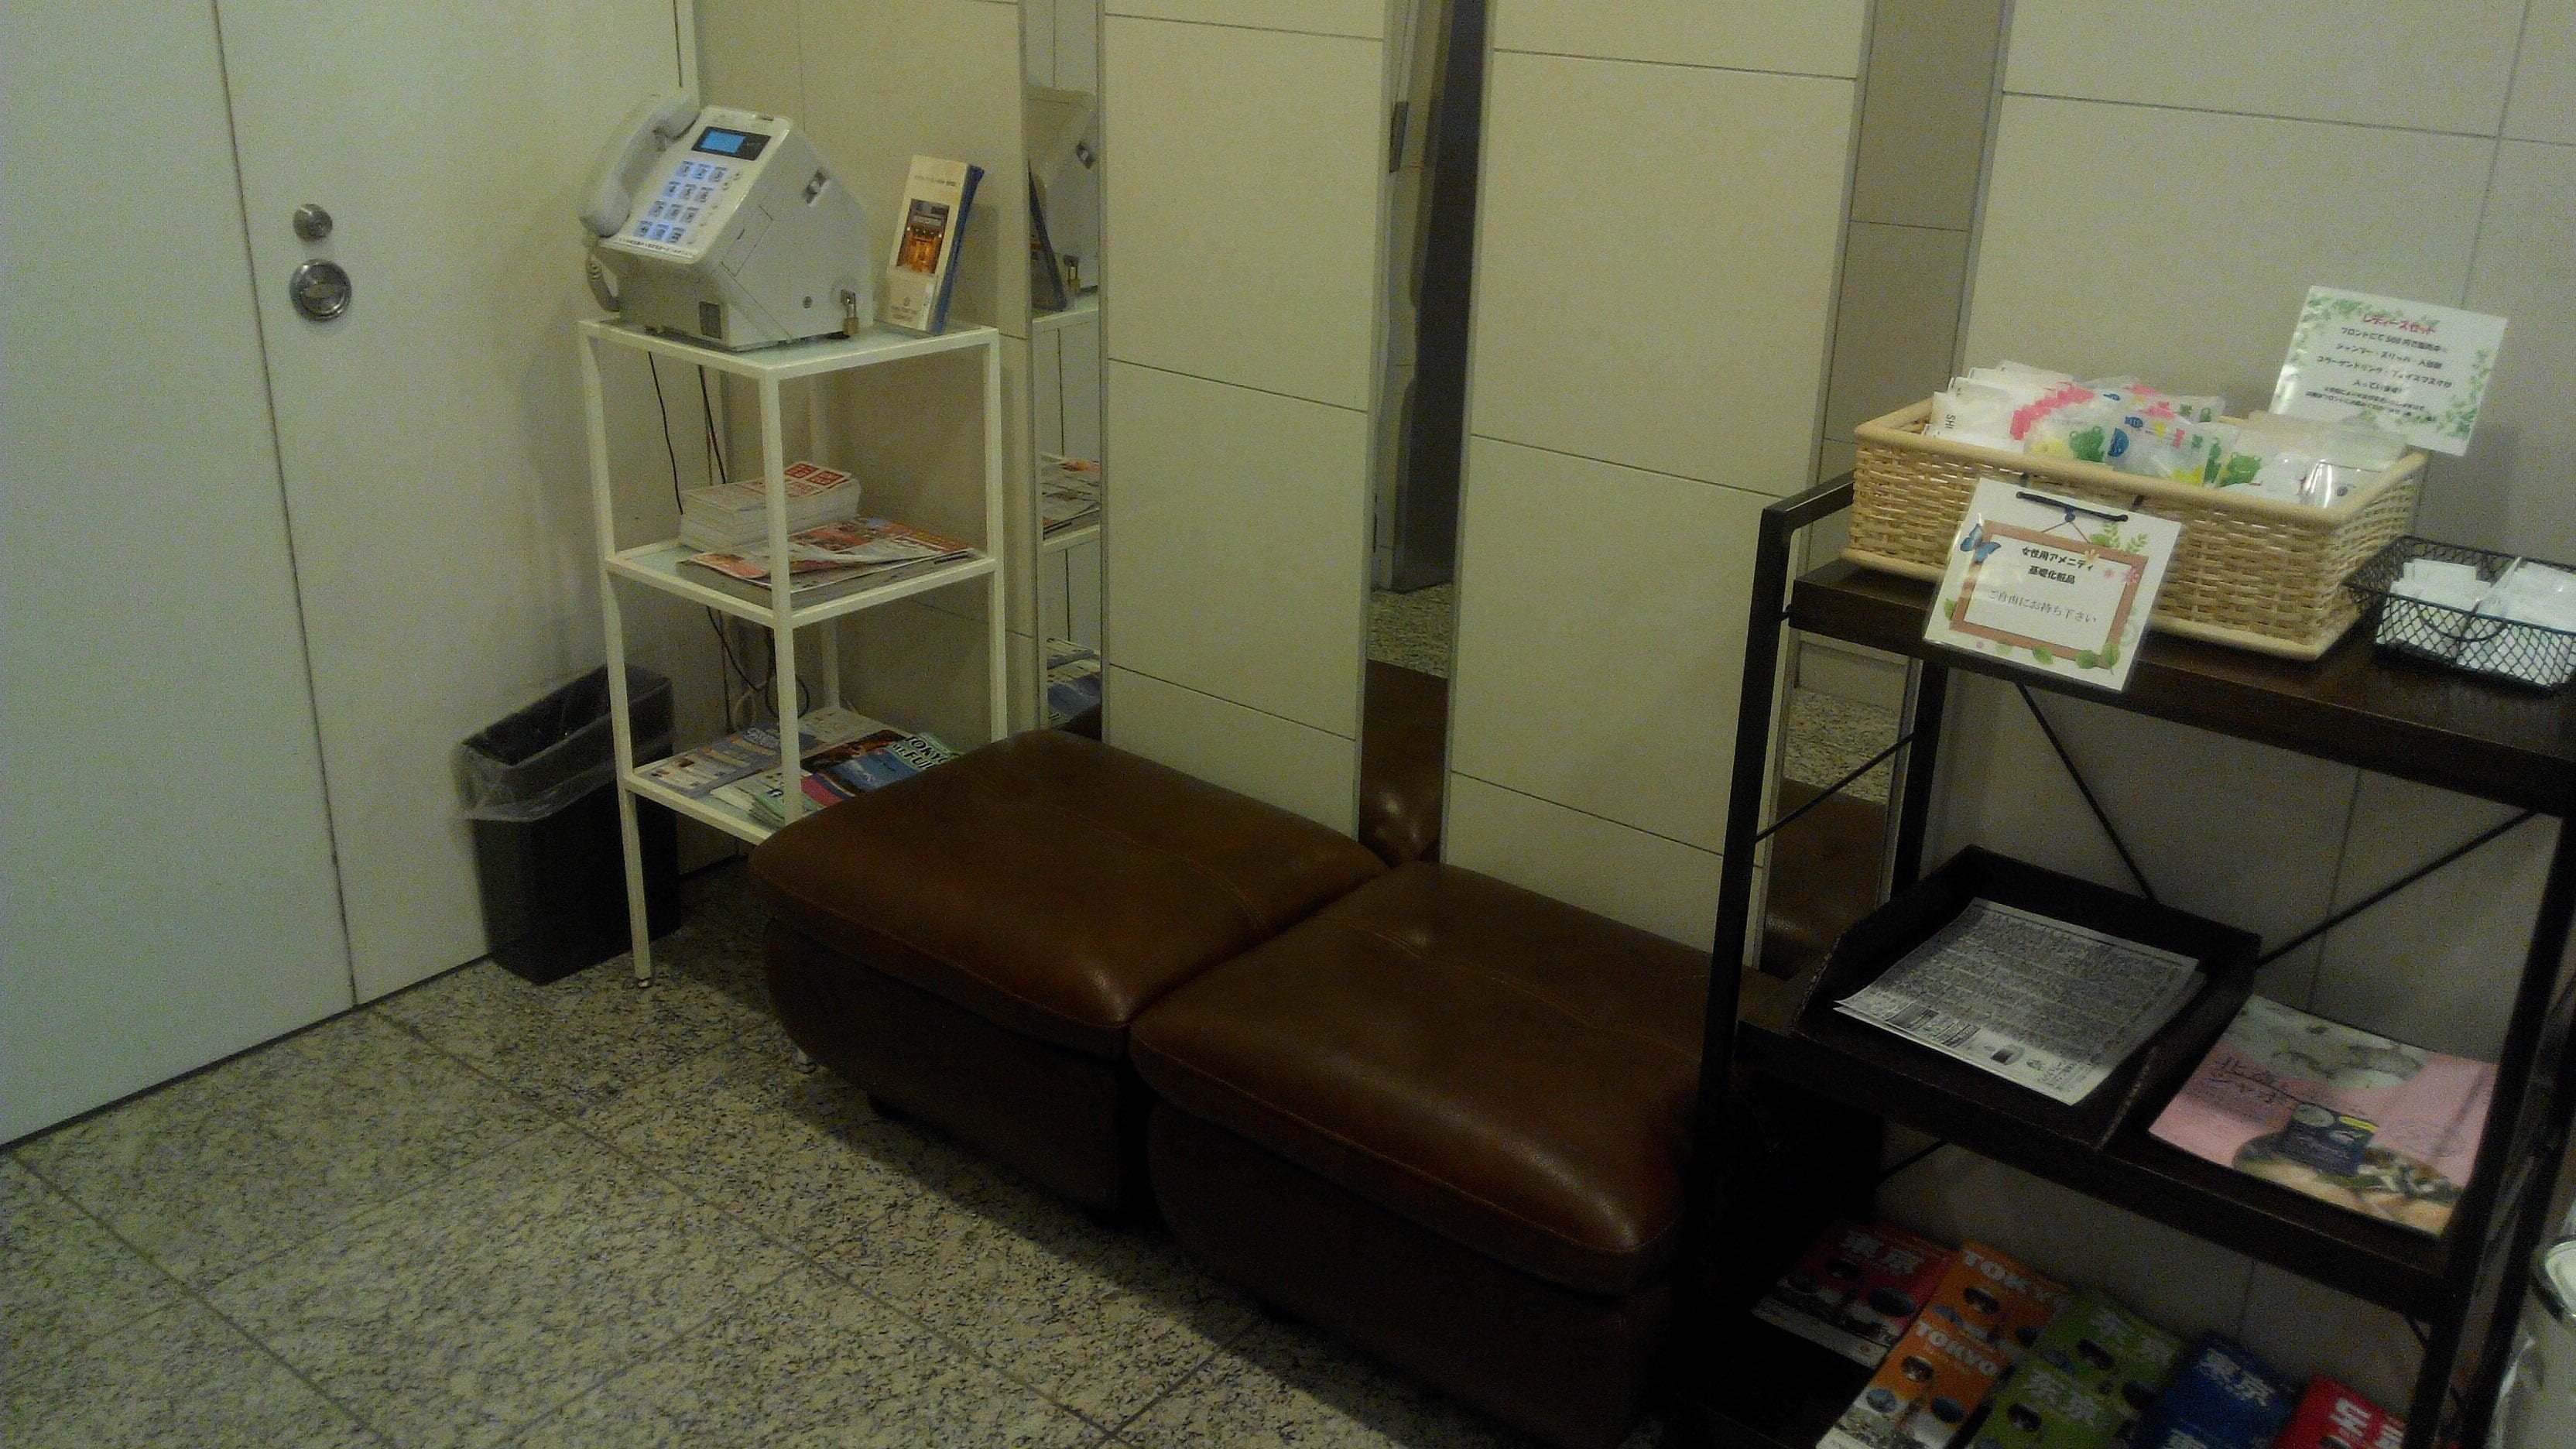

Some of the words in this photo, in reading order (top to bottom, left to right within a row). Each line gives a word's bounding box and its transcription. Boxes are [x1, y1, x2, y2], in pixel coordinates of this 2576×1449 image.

[2021, 546, 2094, 572] 女性用アメニティ
[2027, 565, 2076, 585] 基礎化粧品
[1916, 1320, 1999, 1377] TOKYO
